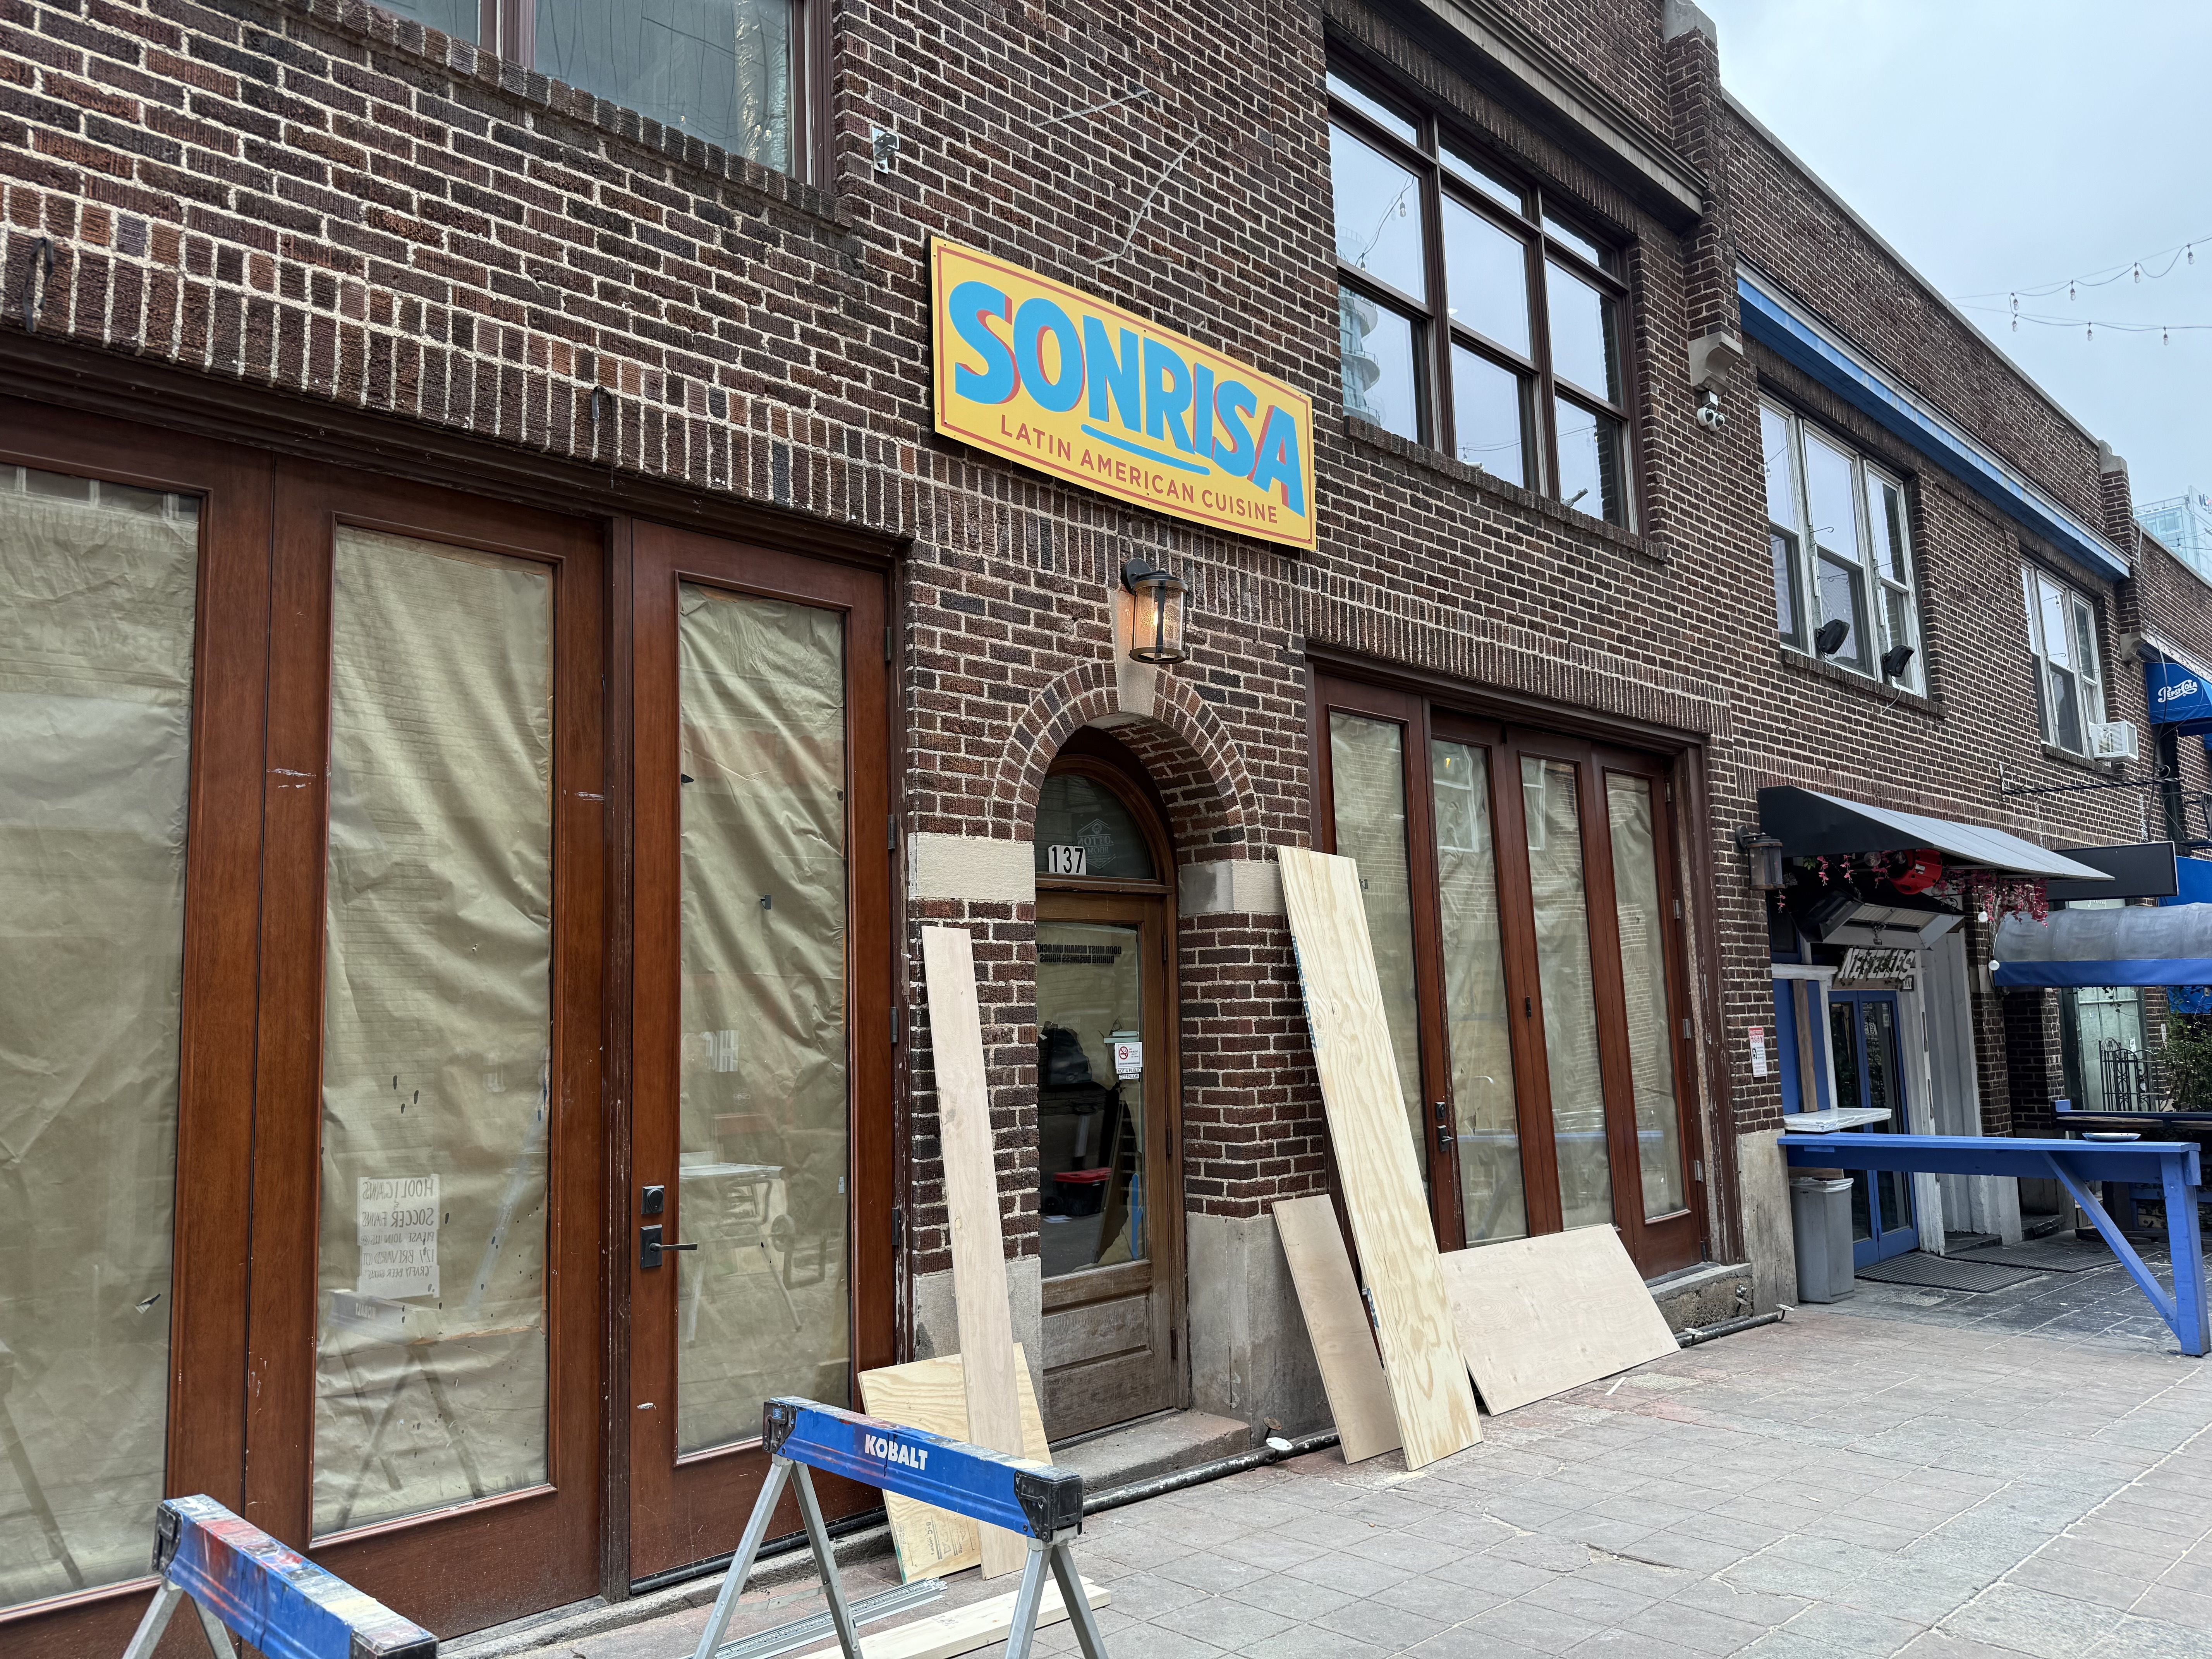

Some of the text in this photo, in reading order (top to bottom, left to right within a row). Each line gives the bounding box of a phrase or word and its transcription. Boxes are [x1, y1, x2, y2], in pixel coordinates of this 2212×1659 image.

[948, 281, 1305, 517] SONRISA
[1001, 414, 1278, 524] LATIN AMERICAN CUISINE
[1052, 846, 1084, 874] 137
[865, 1434, 928, 1470] KOBALT
